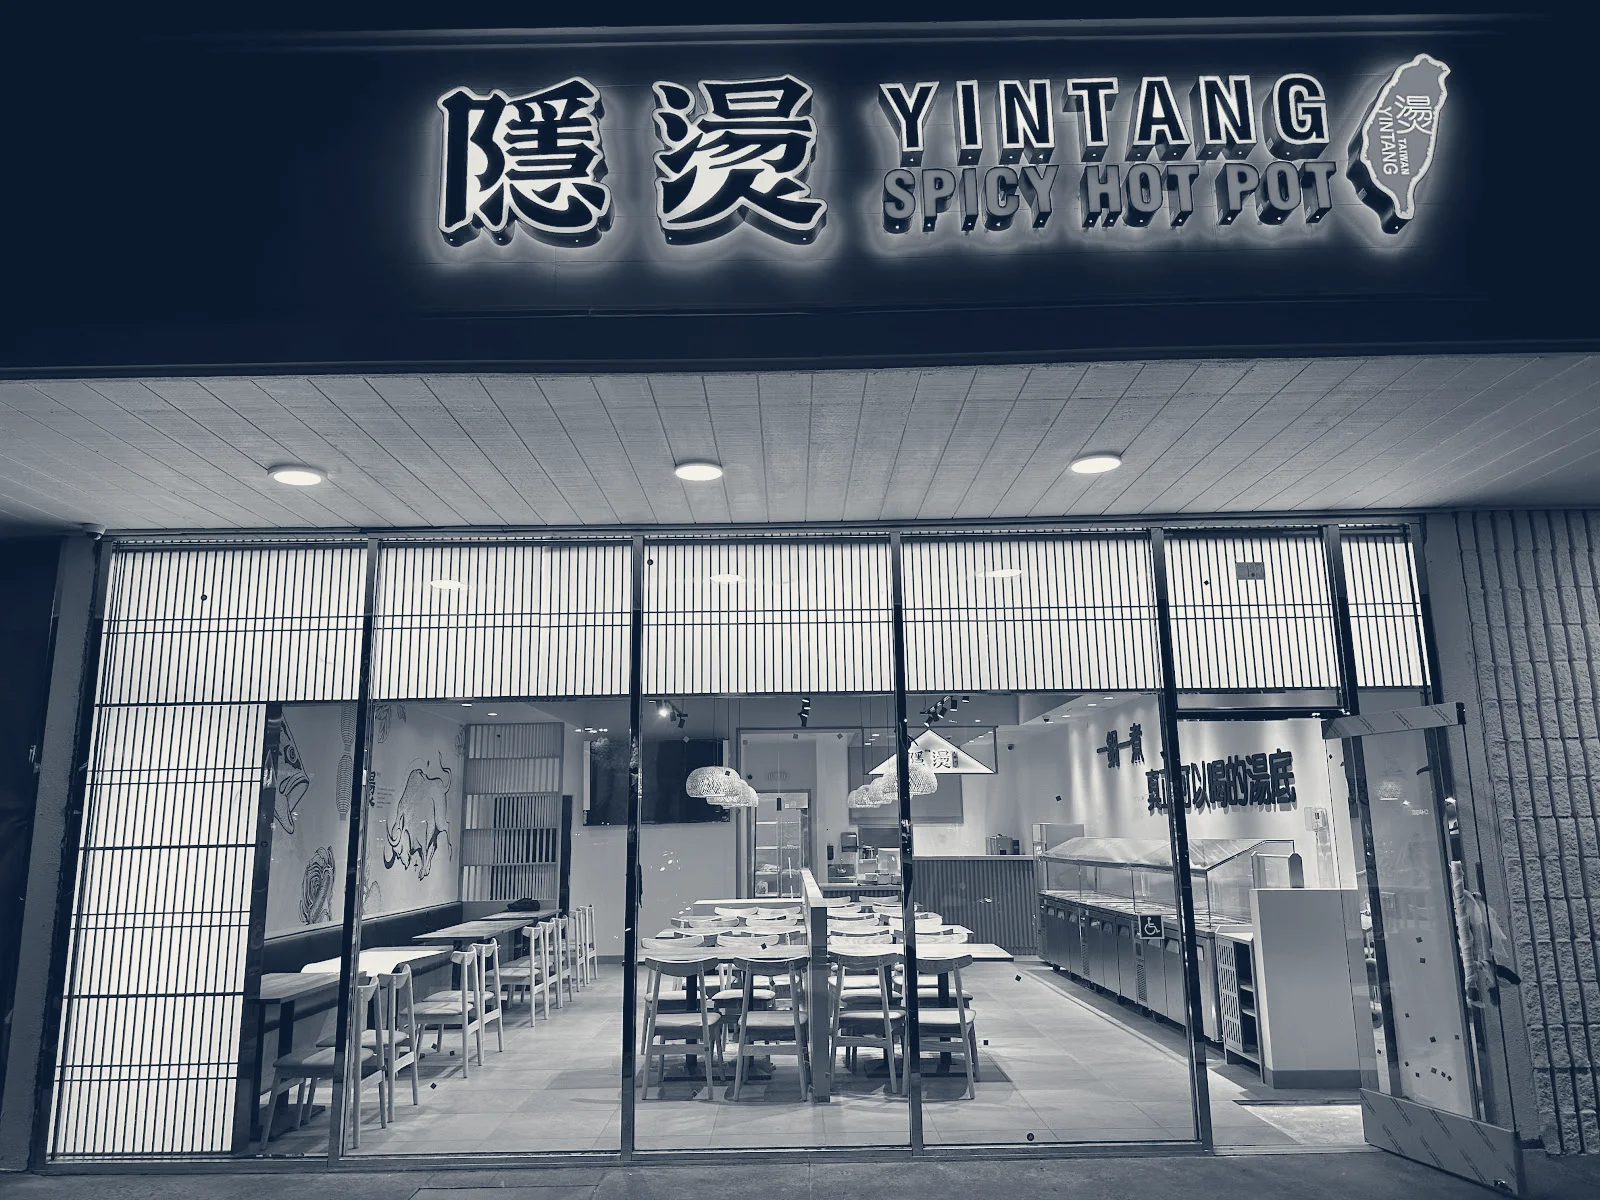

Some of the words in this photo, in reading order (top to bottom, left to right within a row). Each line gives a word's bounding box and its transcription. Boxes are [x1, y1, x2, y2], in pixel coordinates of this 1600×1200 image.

[879, 73, 1330, 154] YINTANG
[1378, 106, 1399, 176] YINTANG
[1394, 94, 1434, 135] 燙
[437, 75, 828, 238] 隱燙
[1397, 137, 1411, 176] TAIWAN
[882, 163, 1059, 222] SPICY
[1086, 162, 1200, 217] HOT
[1225, 160, 1338, 216] POT
